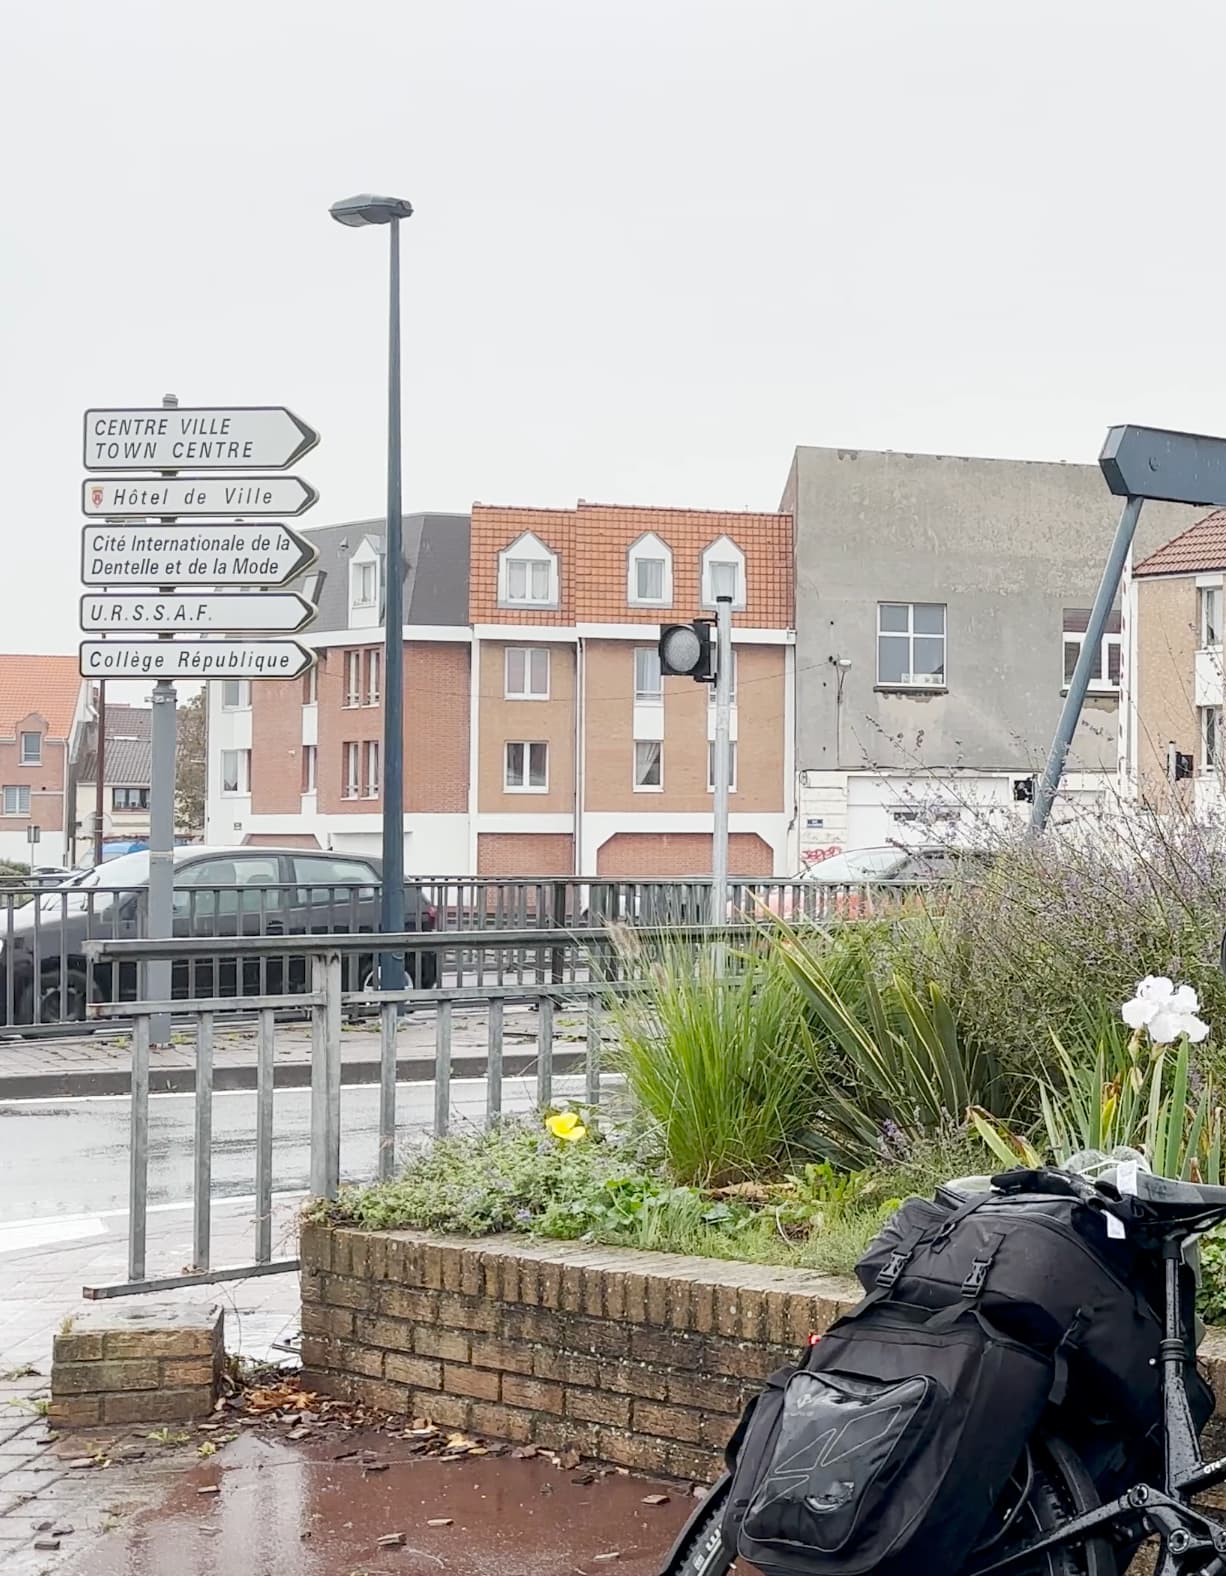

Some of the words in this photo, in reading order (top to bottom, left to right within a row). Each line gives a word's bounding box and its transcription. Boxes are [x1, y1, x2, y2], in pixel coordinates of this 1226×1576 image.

[94, 418, 168, 436] CENTRE
[180, 418, 231, 435] VILLE
[96, 442, 157, 459] TOWN
[172, 441, 253, 458] CENTRE
[113, 488, 168, 505] Hôtel
[184, 488, 206, 505] de
[224, 487, 273, 505] Ville
[92, 535, 126, 552] Cité
[131, 535, 245, 551] Internationale
[251, 535, 270, 551] de
[276, 534, 290, 551] la
[91, 558, 159, 575] Dentelle
[165, 560, 182, 575] et
[188, 558, 207, 575] de
[213, 558, 226, 575] la
[232, 558, 279, 575] Mode
[90, 604, 213, 621] U.R.S.S.A.F.
[89, 651, 164, 672] Collège
[178, 650, 290, 672] République
